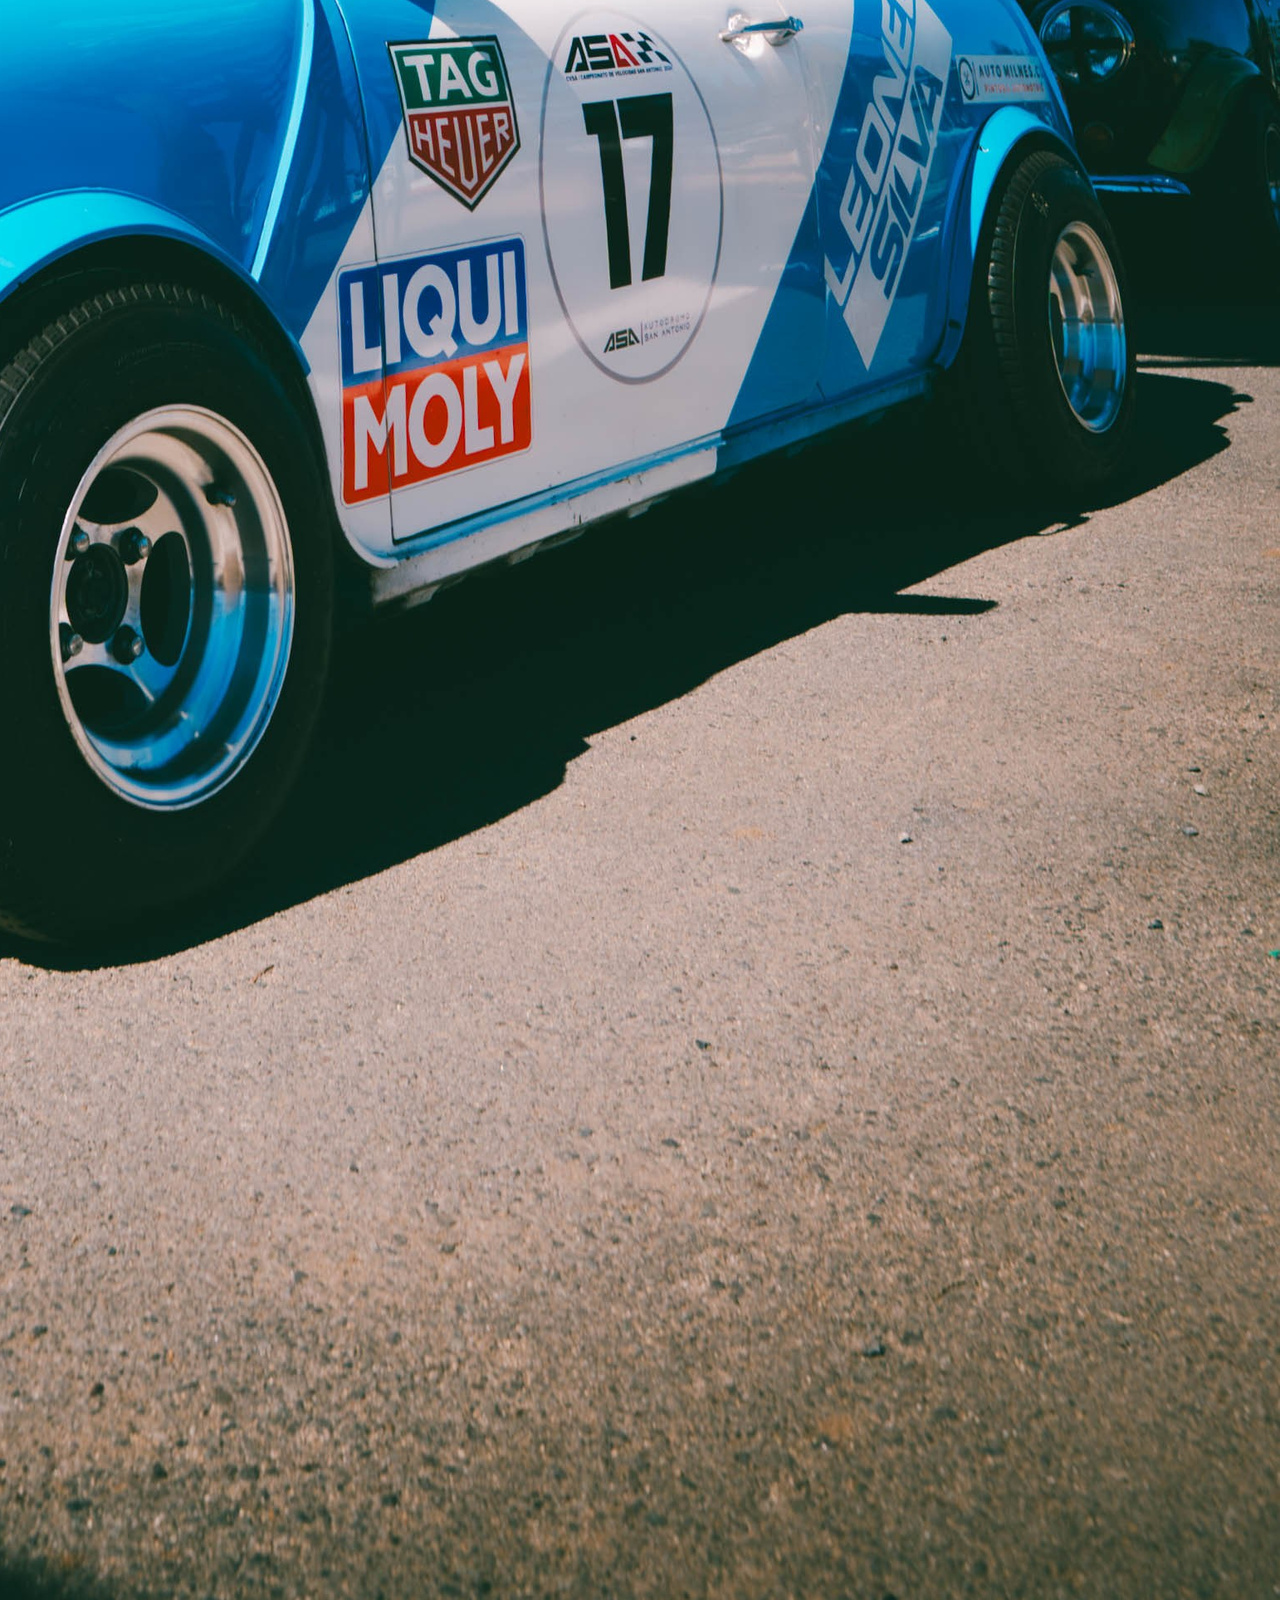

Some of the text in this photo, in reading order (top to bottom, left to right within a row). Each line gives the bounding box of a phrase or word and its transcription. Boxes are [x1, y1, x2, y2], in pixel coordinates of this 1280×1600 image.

[403, 51, 500, 102] TAG
[564, 33, 641, 74] ASA
[978, 64, 1001, 78] AUTO
[413, 112, 511, 191] HEUER
[869, 64, 944, 301] SILVA
[581, 92, 674, 290] 17
[349, 250, 520, 375] LIQUI
[603, 327, 640, 354] ASA
[644, 321, 691, 342] SAN ANTONIO
[353, 352, 527, 492] MOLY
